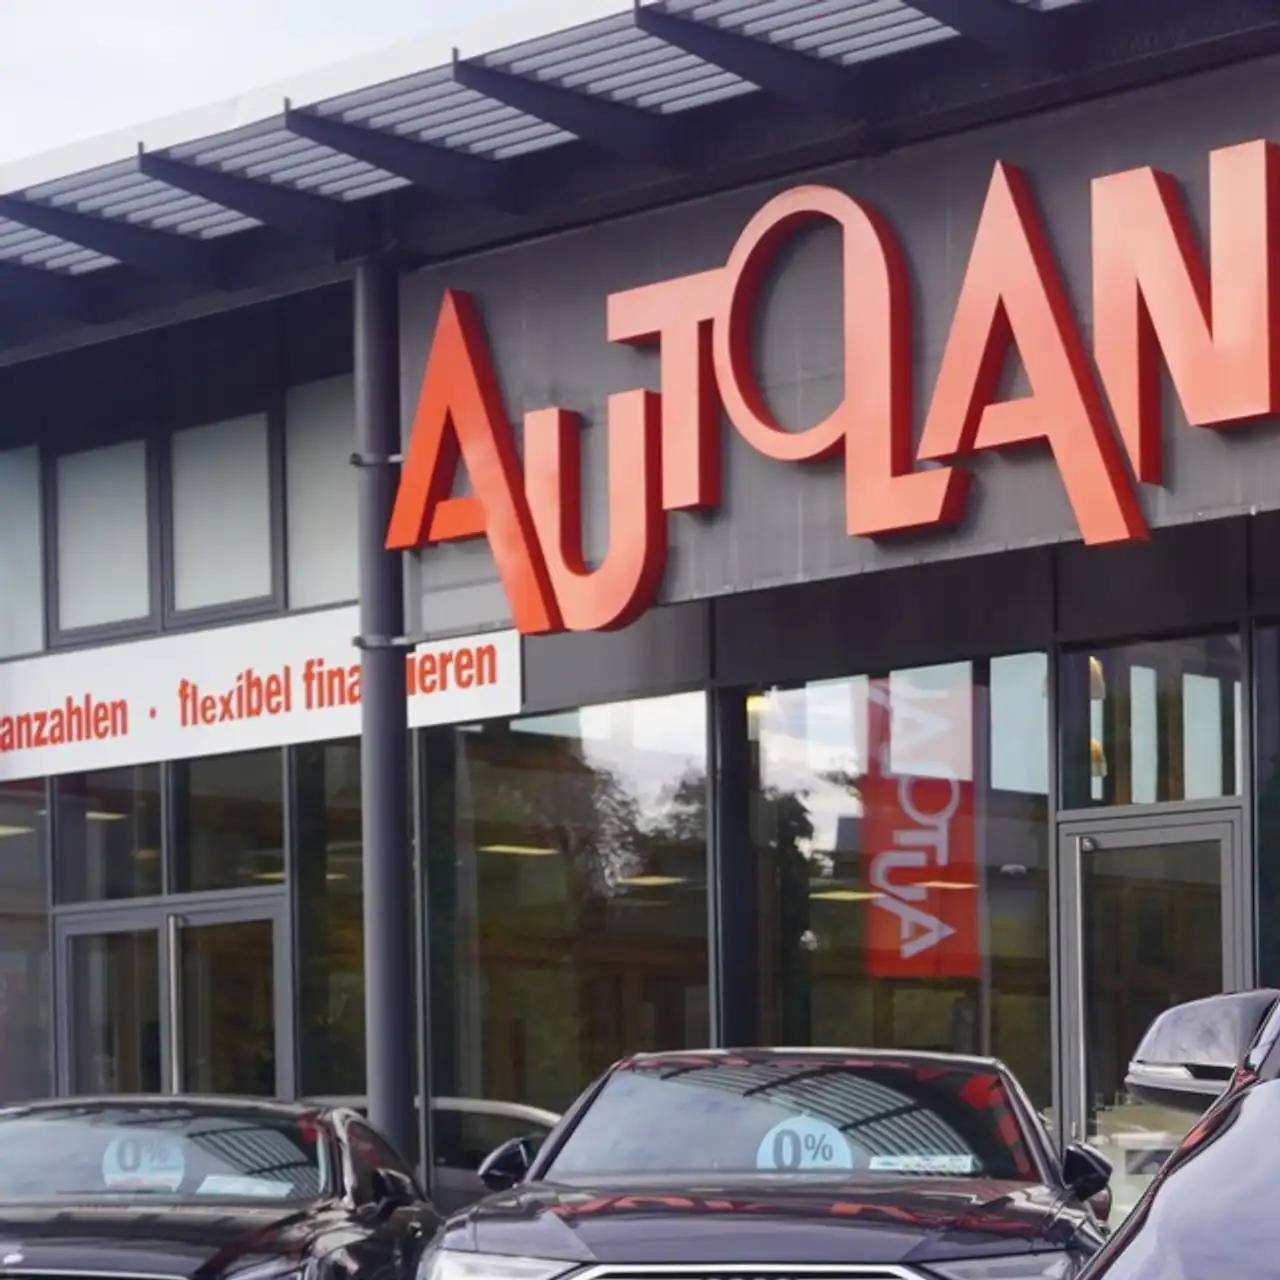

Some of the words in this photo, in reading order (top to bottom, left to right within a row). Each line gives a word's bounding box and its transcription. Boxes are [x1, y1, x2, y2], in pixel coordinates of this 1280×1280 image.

[0, 693, 128, 754] anzahlen
[178, 664, 292, 728] flexibel
[772, 1128, 834, 1170] 0%
